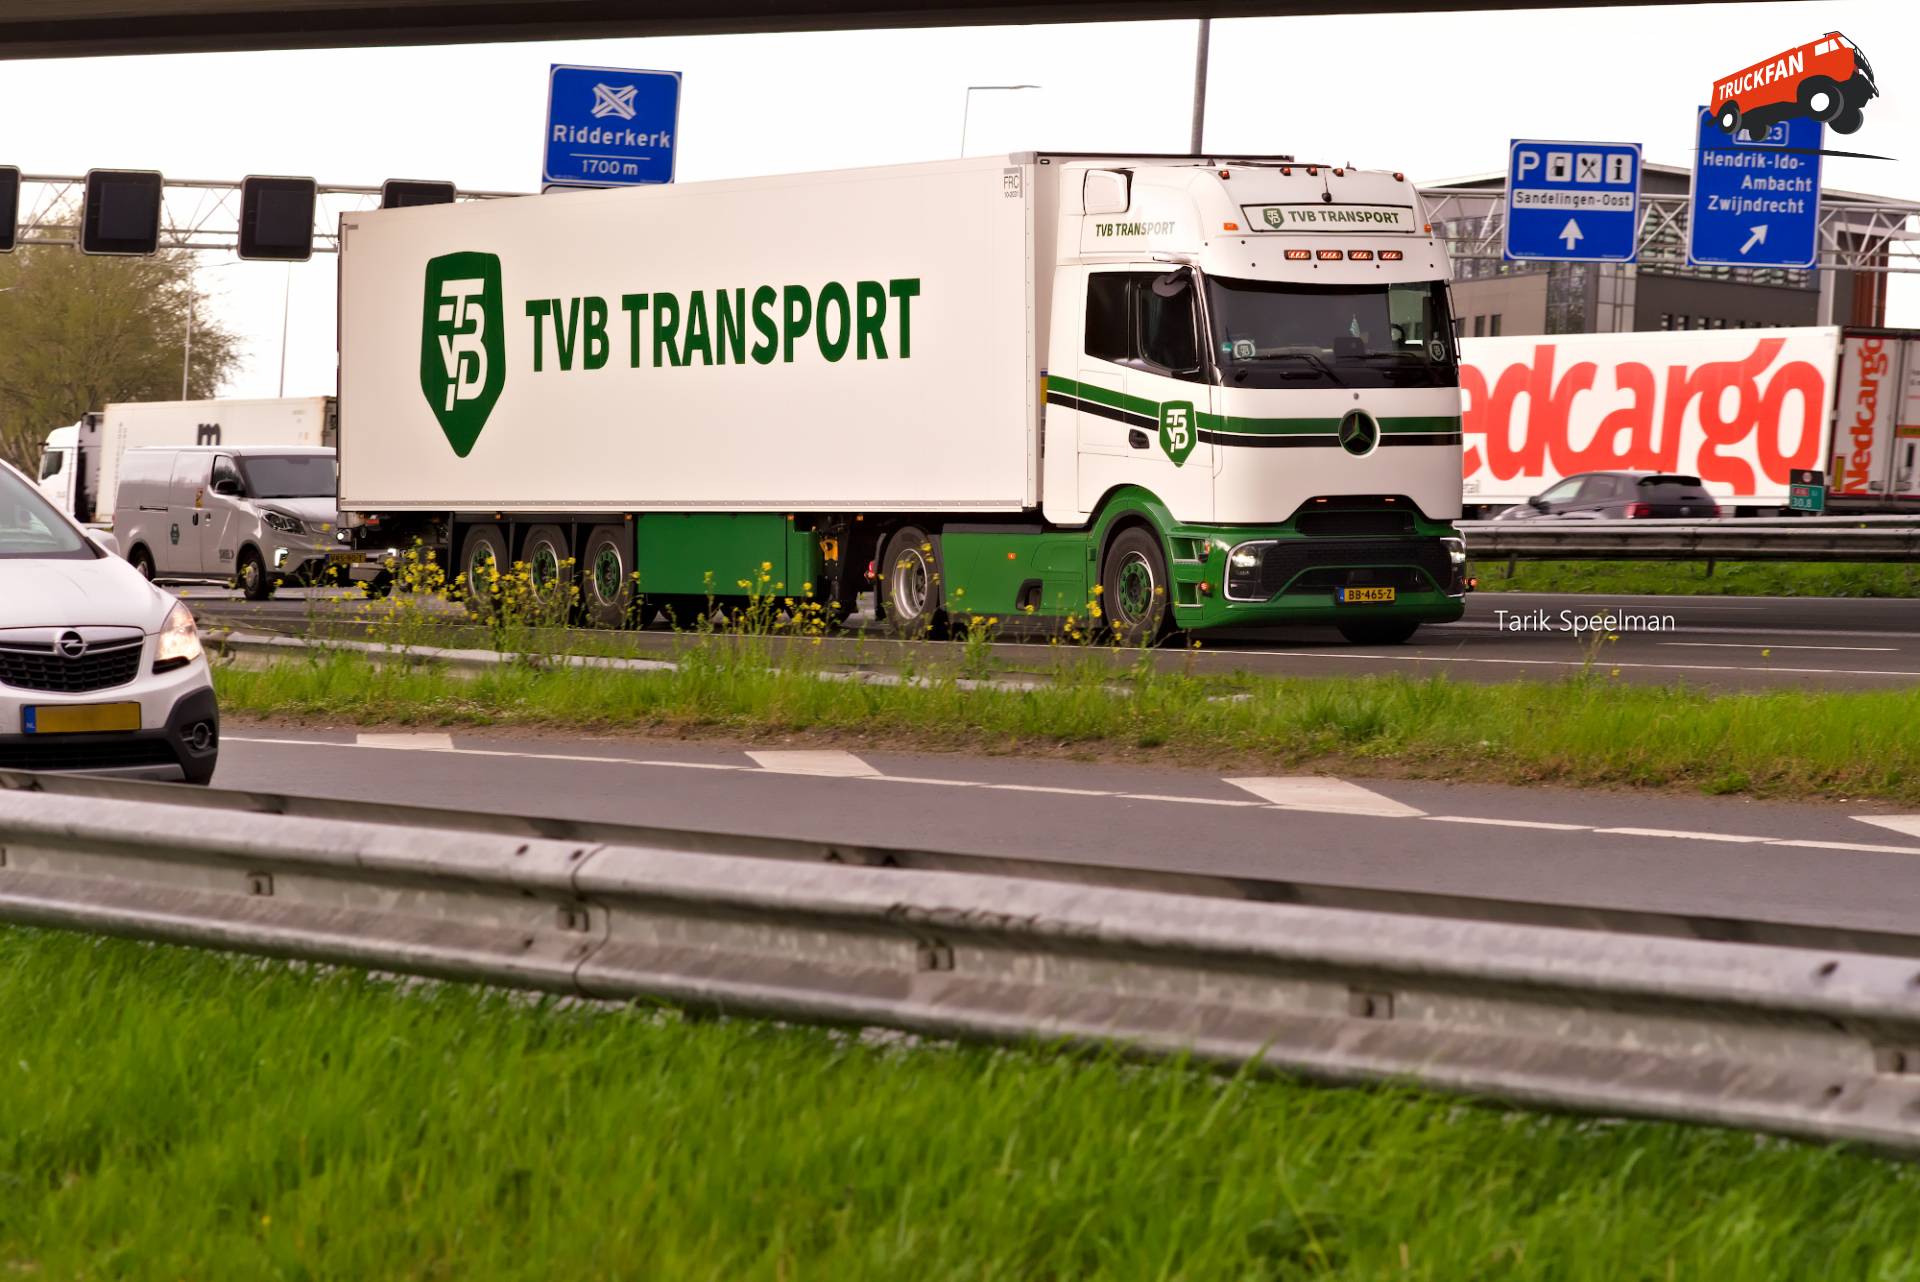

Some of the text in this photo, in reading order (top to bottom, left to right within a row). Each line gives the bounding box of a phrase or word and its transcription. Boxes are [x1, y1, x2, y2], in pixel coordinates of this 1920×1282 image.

[553, 124, 671, 148] Ridderkerk
[582, 160, 639, 175] 1700 m
[1517, 151, 1541, 181] P
[1702, 151, 1806, 170] Hendrik-Ido-
[1003, 175, 1020, 190] FRC
[1740, 174, 1813, 193] Ambacht
[1516, 191, 1630, 208] Sandelingen-Oost
[1707, 195, 1805, 216] Zwijndrecht
[1288, 211, 1399, 224] TVB TRANSPORT
[1096, 221, 1176, 237] TVB TRANSPORT
[526, 278, 920, 372] TVB TRANSPORT
[1843, 338, 1888, 494] Nedcargo
[1348, 589, 1392, 600] BB-465-Z
